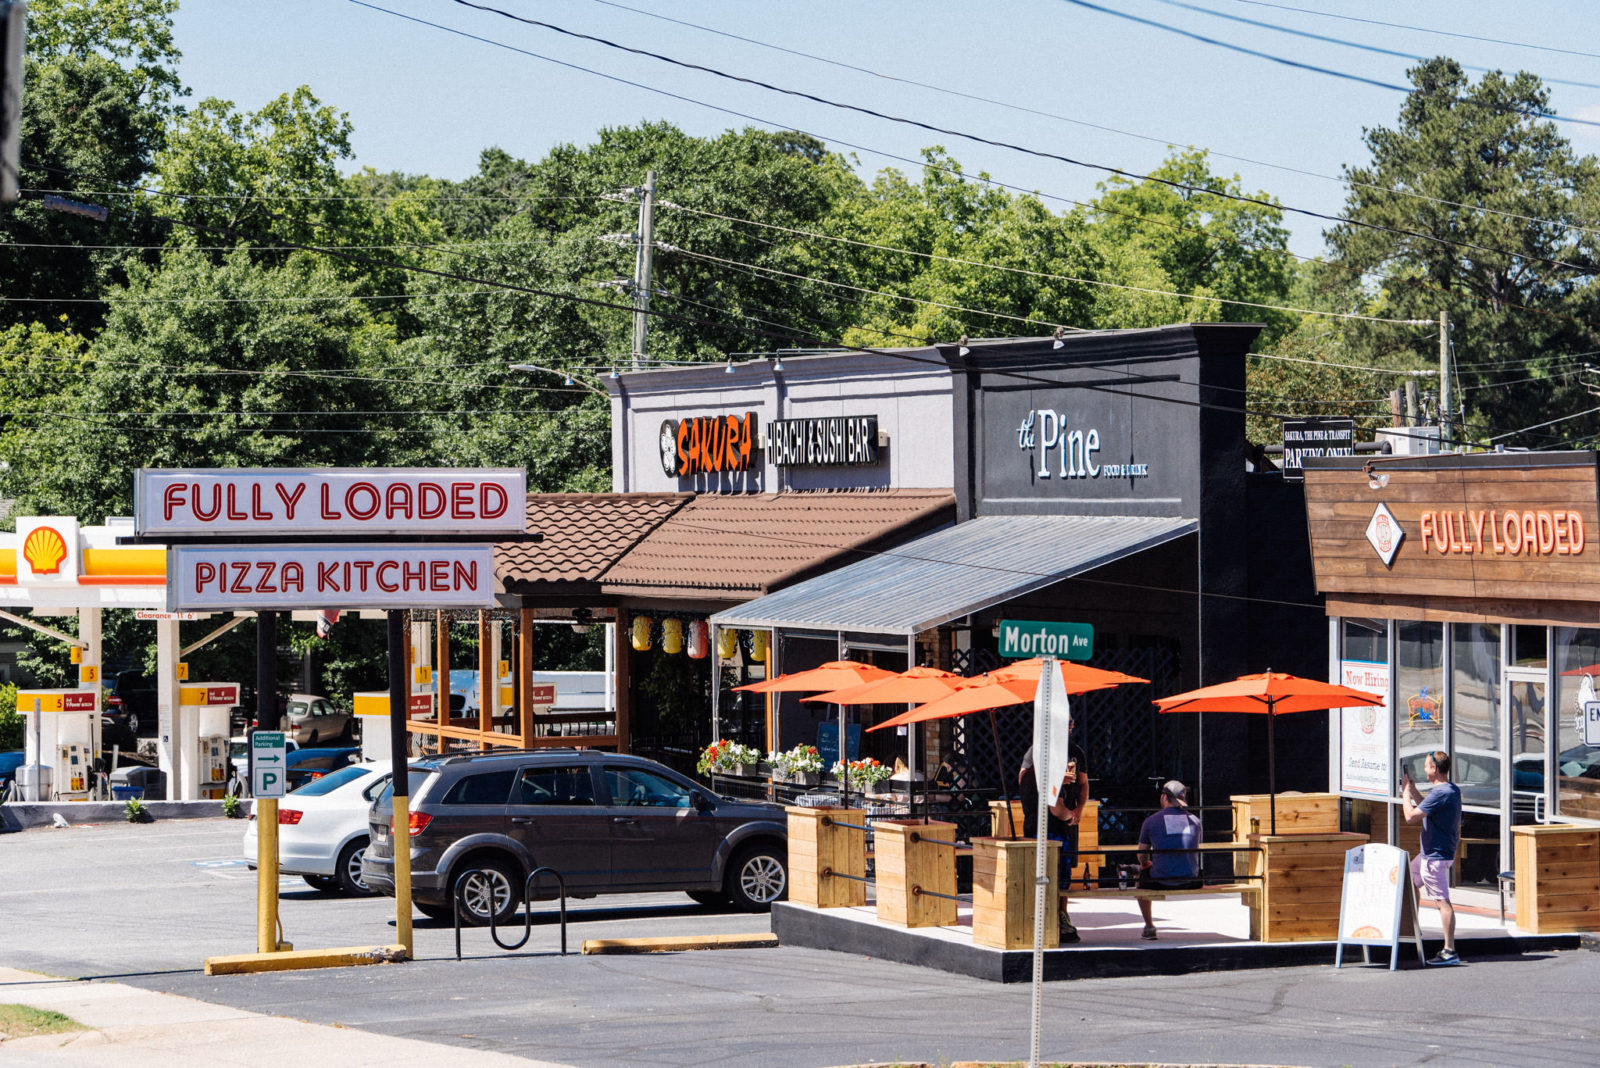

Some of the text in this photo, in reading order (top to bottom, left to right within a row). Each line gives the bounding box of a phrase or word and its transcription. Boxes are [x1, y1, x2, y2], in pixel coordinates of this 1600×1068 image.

[677, 411, 752, 476] SAKURA
[766, 418, 870, 464] HIBACHI & SUSHI BAR
[1016, 409, 1100, 478] the Pine
[1285, 431, 1304, 442] SAKURA,
[1304, 431, 1313, 440] THE
[1313, 430, 1324, 440] PINE
[1104, 463, 1148, 476] FOOD & DRINK
[163, 482, 509, 521] FULLY LOADED
[1420, 510, 1585, 554] FULLY LOADED
[195, 560, 478, 594] PIZZA KITCHEN
[136, 611, 171, 619] Clearance
[1005, 626, 1088, 654] Morton Ave
[89, 668, 95, 679] 5
[180, 666, 185, 677] 7
[1345, 670, 1389, 691] Now Hiring
[57, 698, 63, 708] 5
[200, 692, 206, 702] 7
[263, 772, 277, 790] P
